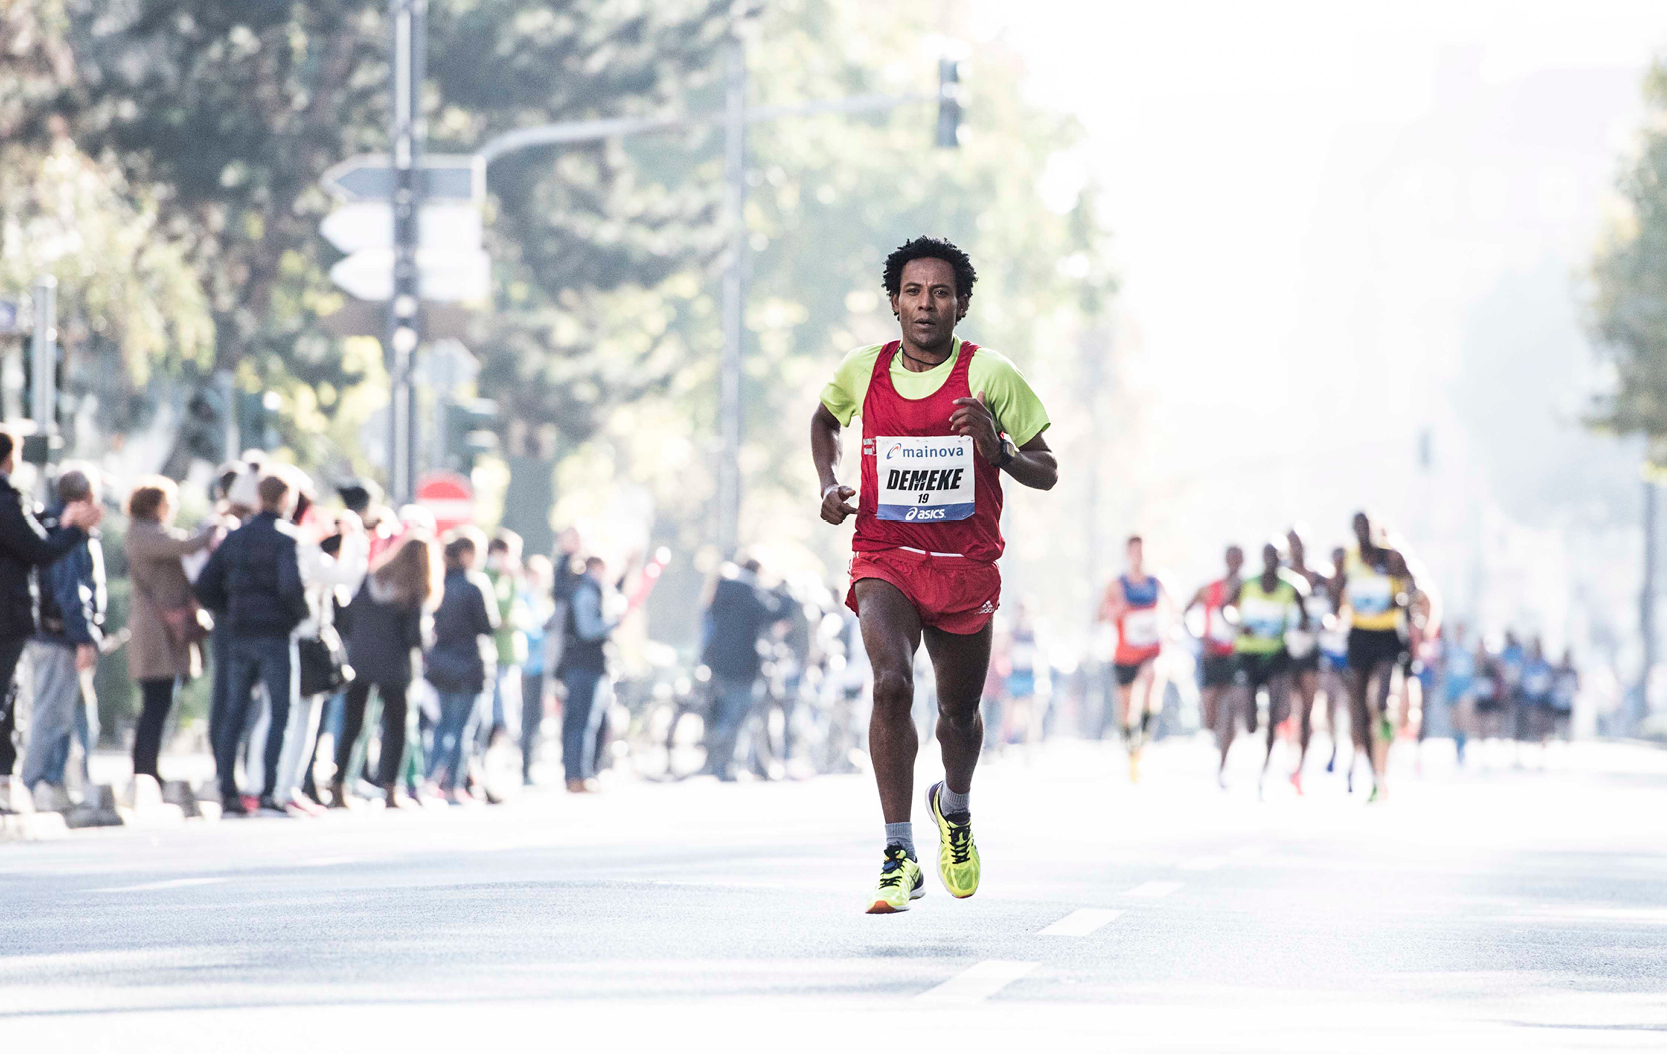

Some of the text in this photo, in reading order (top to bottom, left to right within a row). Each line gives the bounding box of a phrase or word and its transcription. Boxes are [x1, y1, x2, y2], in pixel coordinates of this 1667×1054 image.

[902, 445, 964, 458] mainova
[886, 468, 964, 491] DEMEKE
[918, 493, 929, 504] 19
